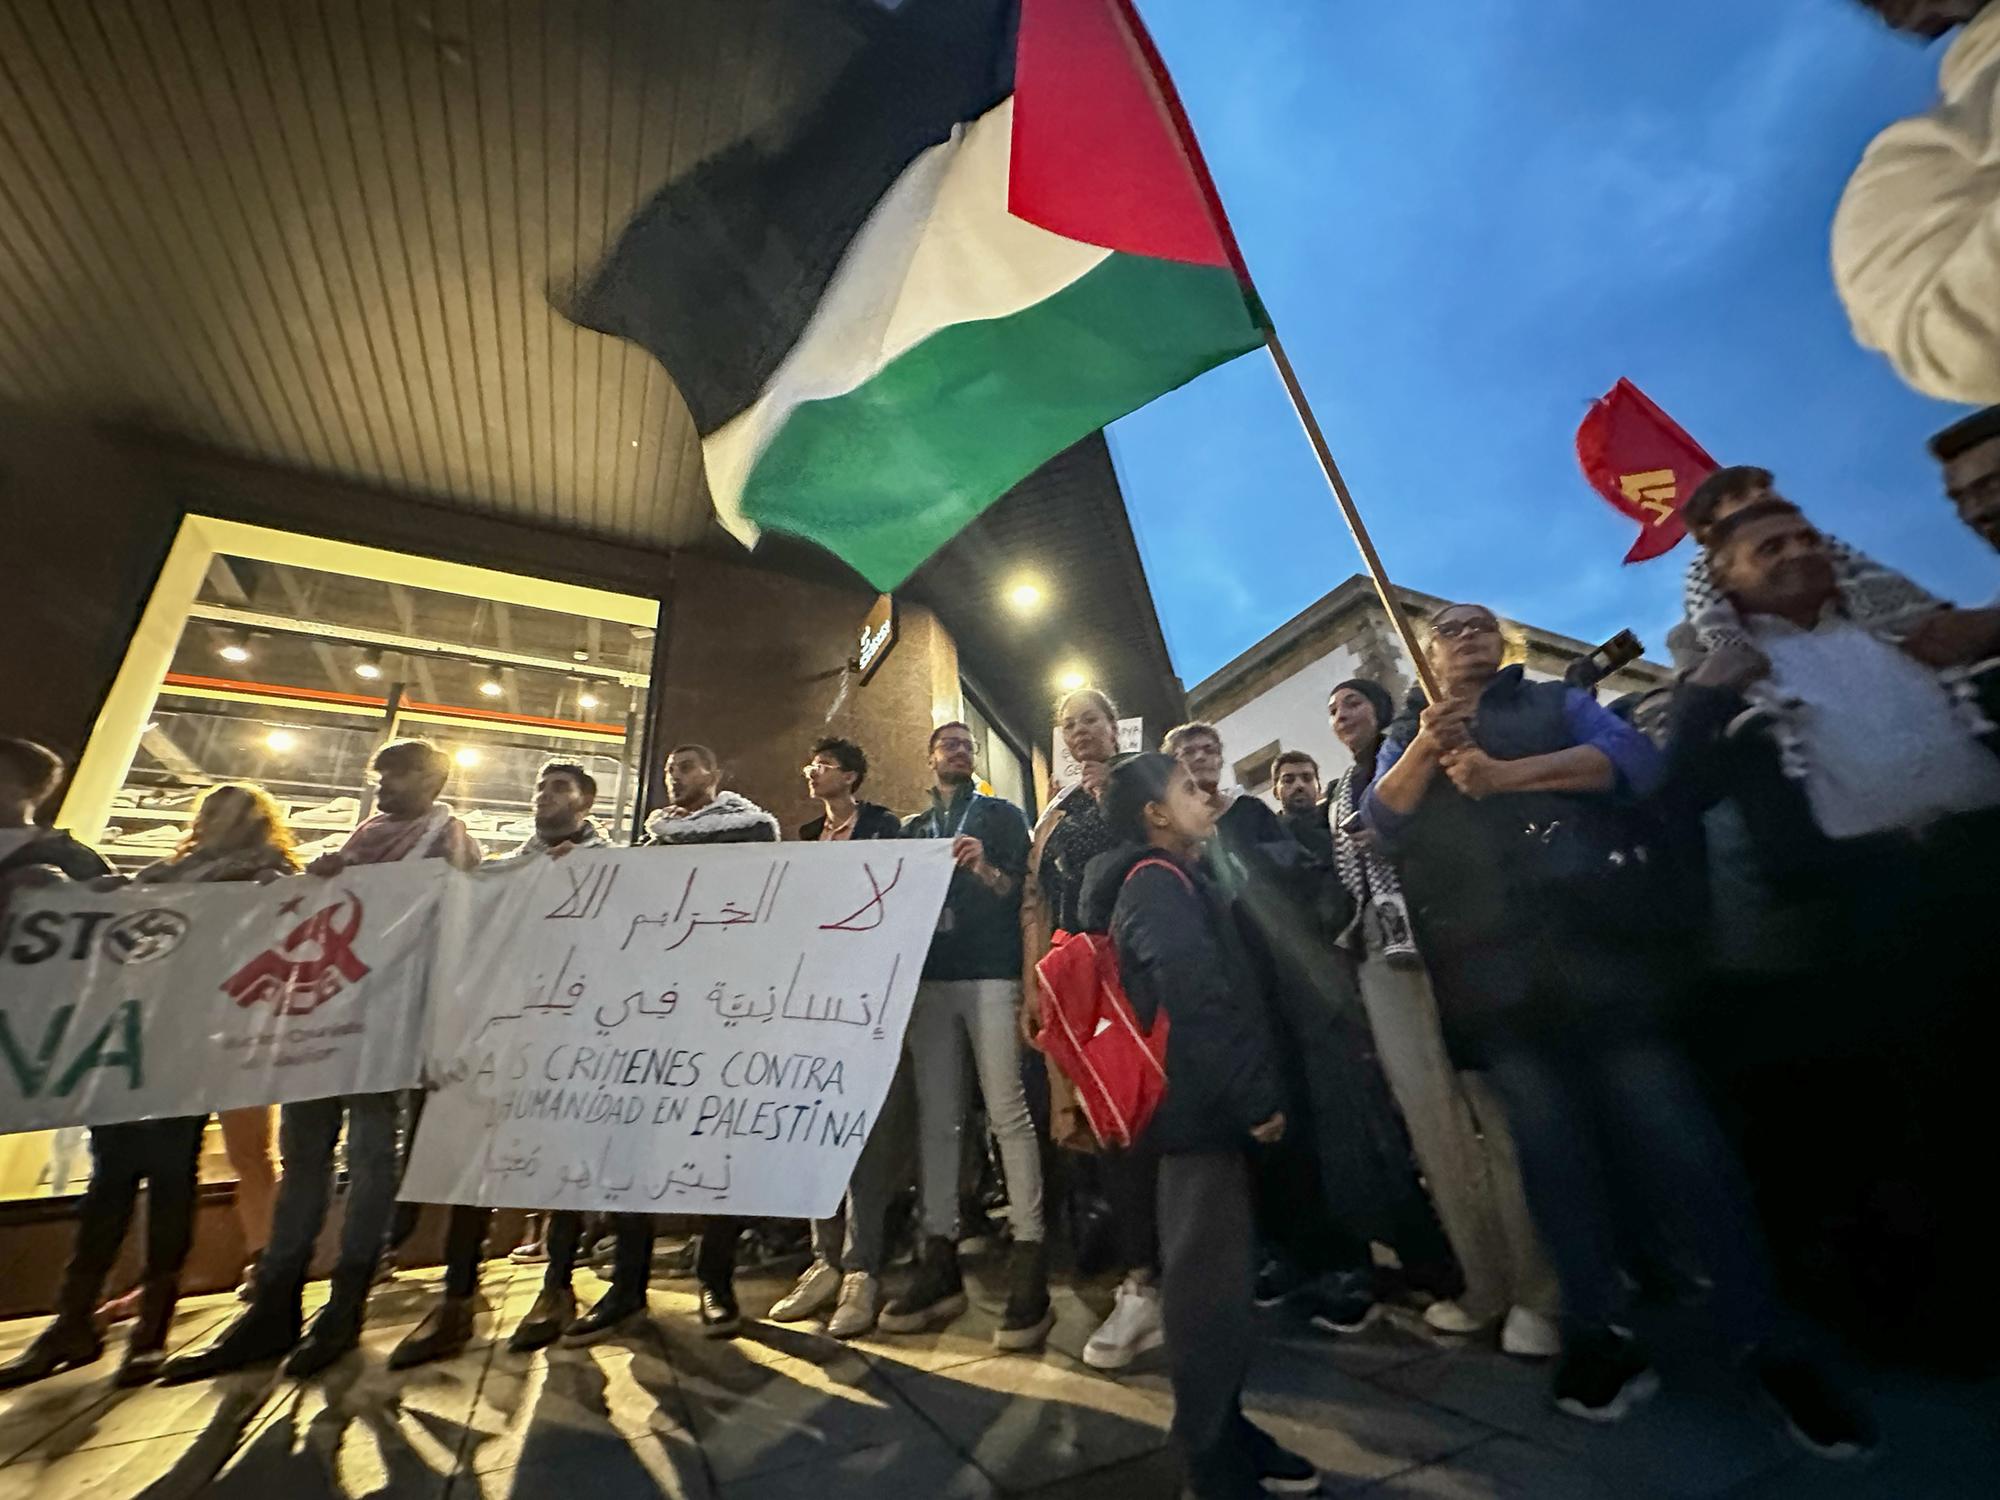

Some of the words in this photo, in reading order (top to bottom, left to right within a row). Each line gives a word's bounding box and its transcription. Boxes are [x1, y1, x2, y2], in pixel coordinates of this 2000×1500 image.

[819, 857, 904, 931] لا
[720, 1050, 844, 1095] CONTRA
[652, 1096, 689, 1125] EN
